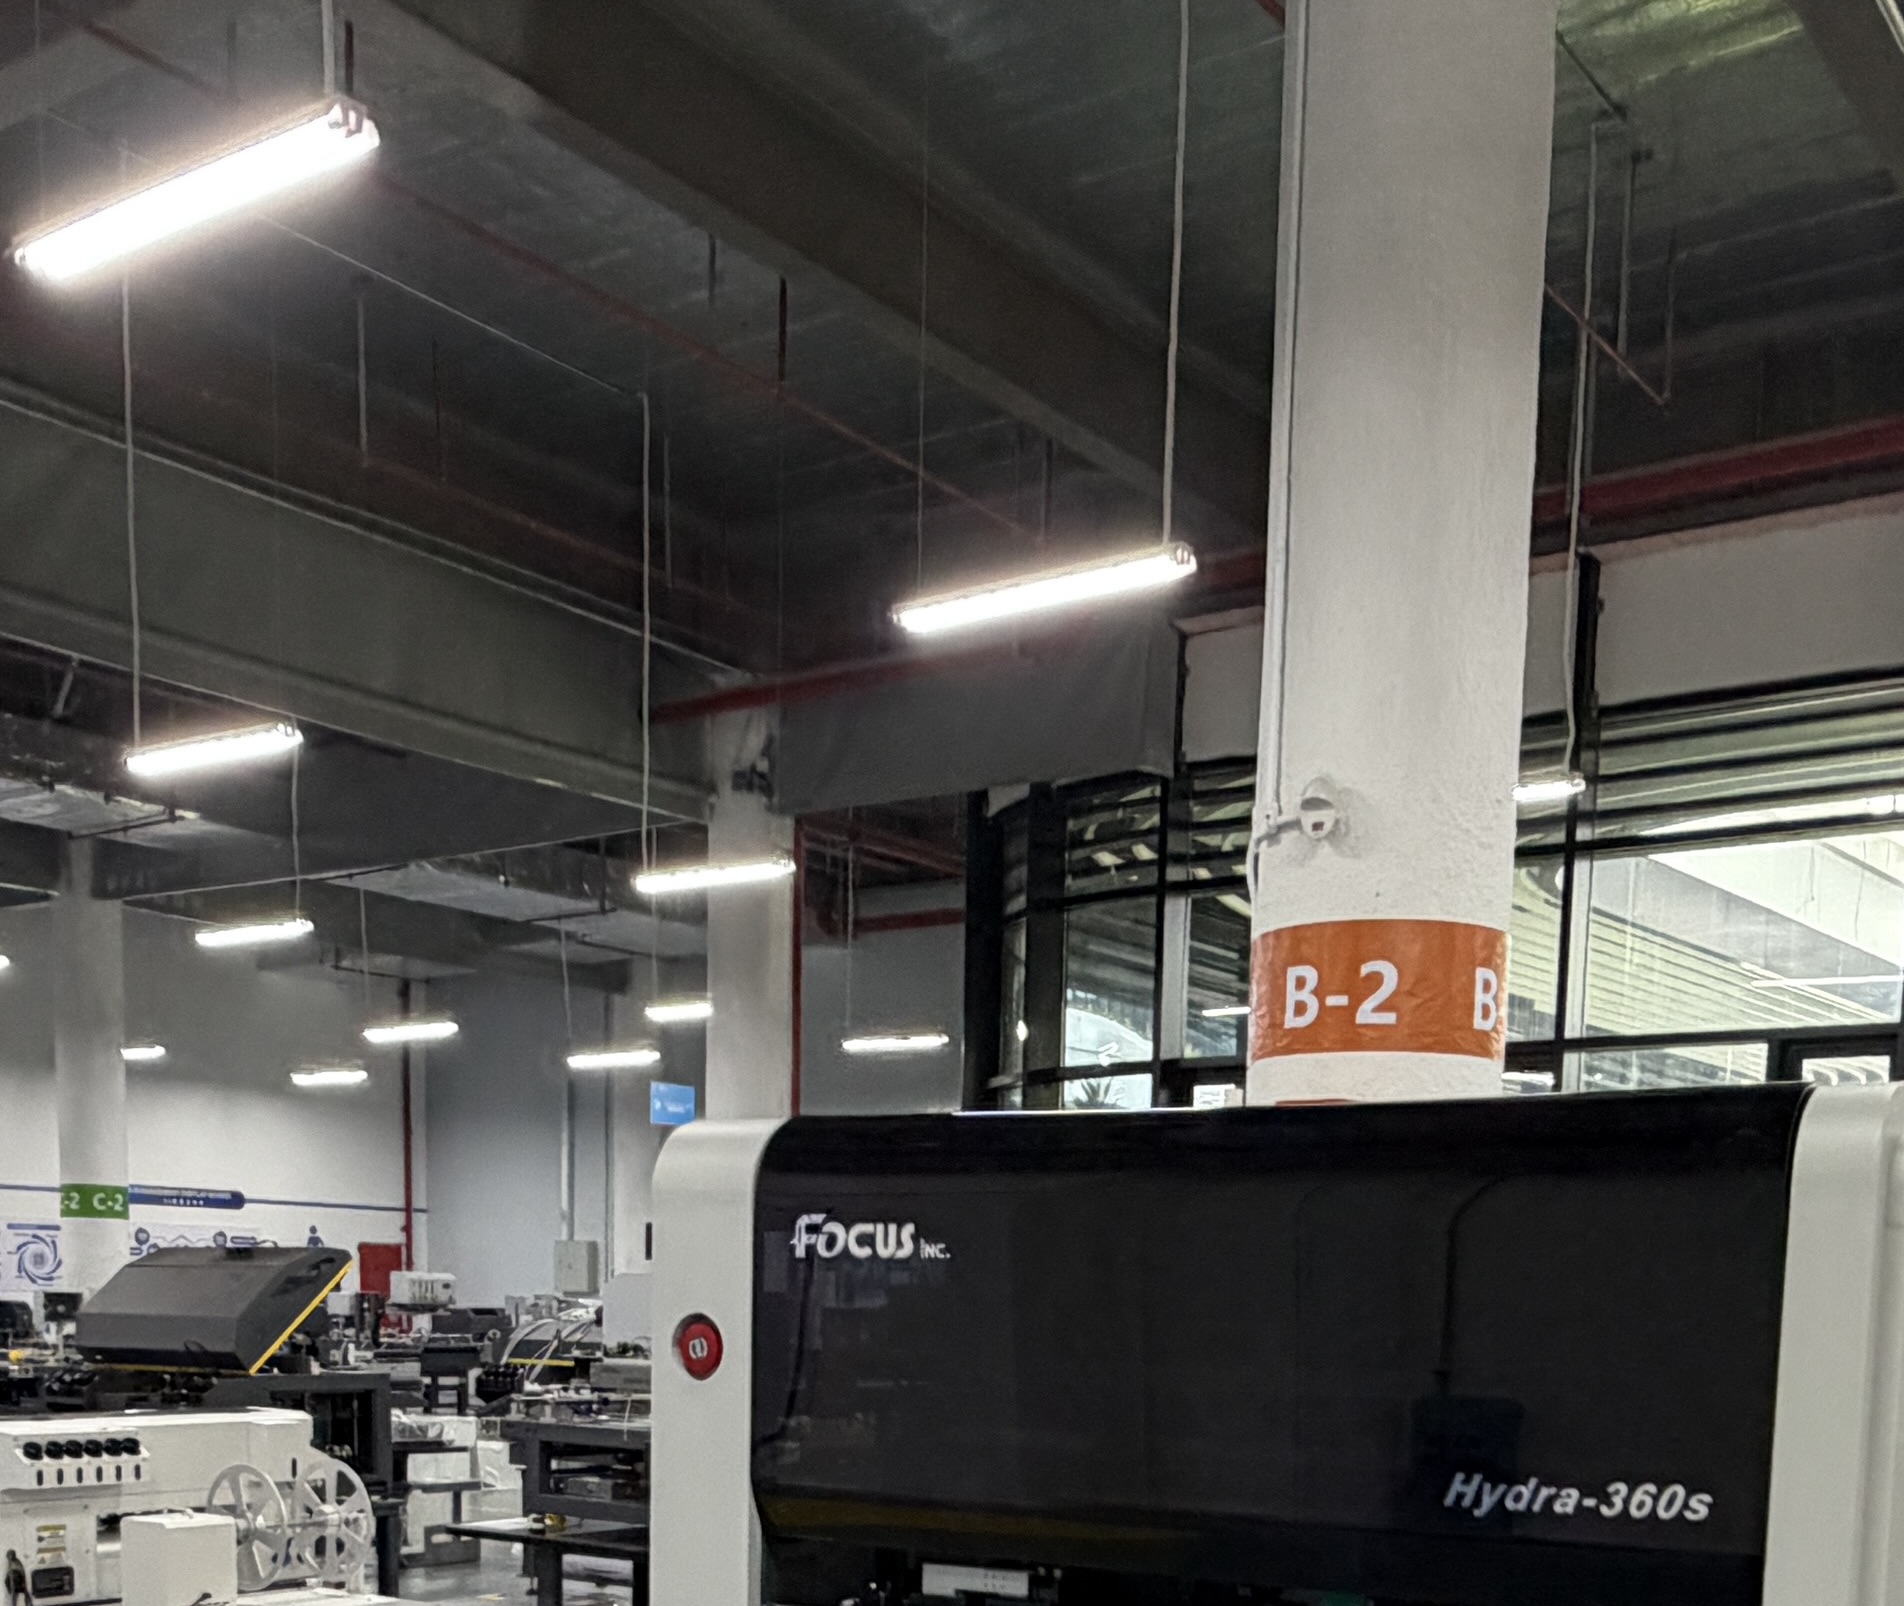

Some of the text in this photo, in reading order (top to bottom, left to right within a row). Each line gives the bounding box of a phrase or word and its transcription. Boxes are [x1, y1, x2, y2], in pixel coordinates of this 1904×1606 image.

[1284, 960, 1399, 1029] B-2
[1473, 967, 1498, 1030] B
[92, 1192, 124, 1211] C-2
[1443, 1471, 1715, 1522] Hydra-360s
